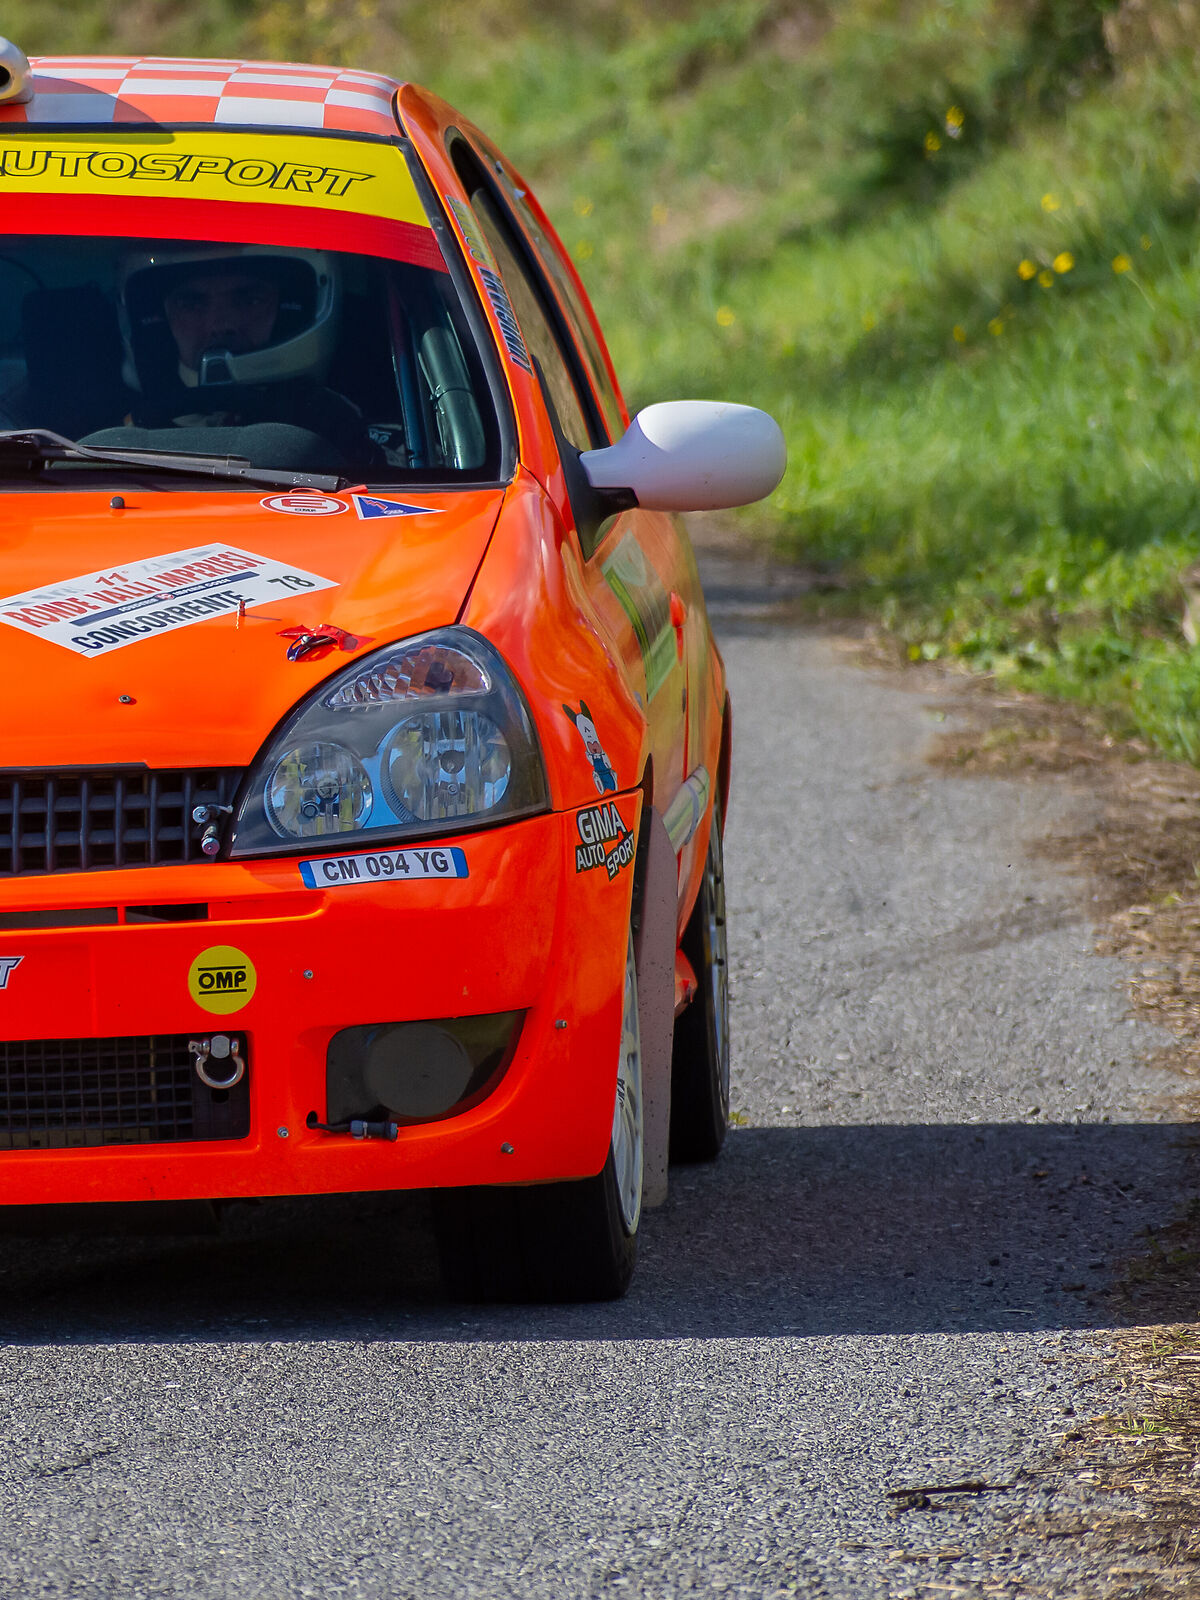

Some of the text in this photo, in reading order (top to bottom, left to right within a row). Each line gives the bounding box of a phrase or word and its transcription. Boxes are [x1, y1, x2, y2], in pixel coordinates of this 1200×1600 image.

[2, 551, 266, 628] RONDE VALLI IMPERIESI
[71, 575, 316, 650] CONCORRENTE 78
[577, 803, 627, 844] GIMA
[322, 850, 449, 881] CM 094 YG
[577, 843, 606, 870] AUTO
[198, 970, 247, 990] OMP
